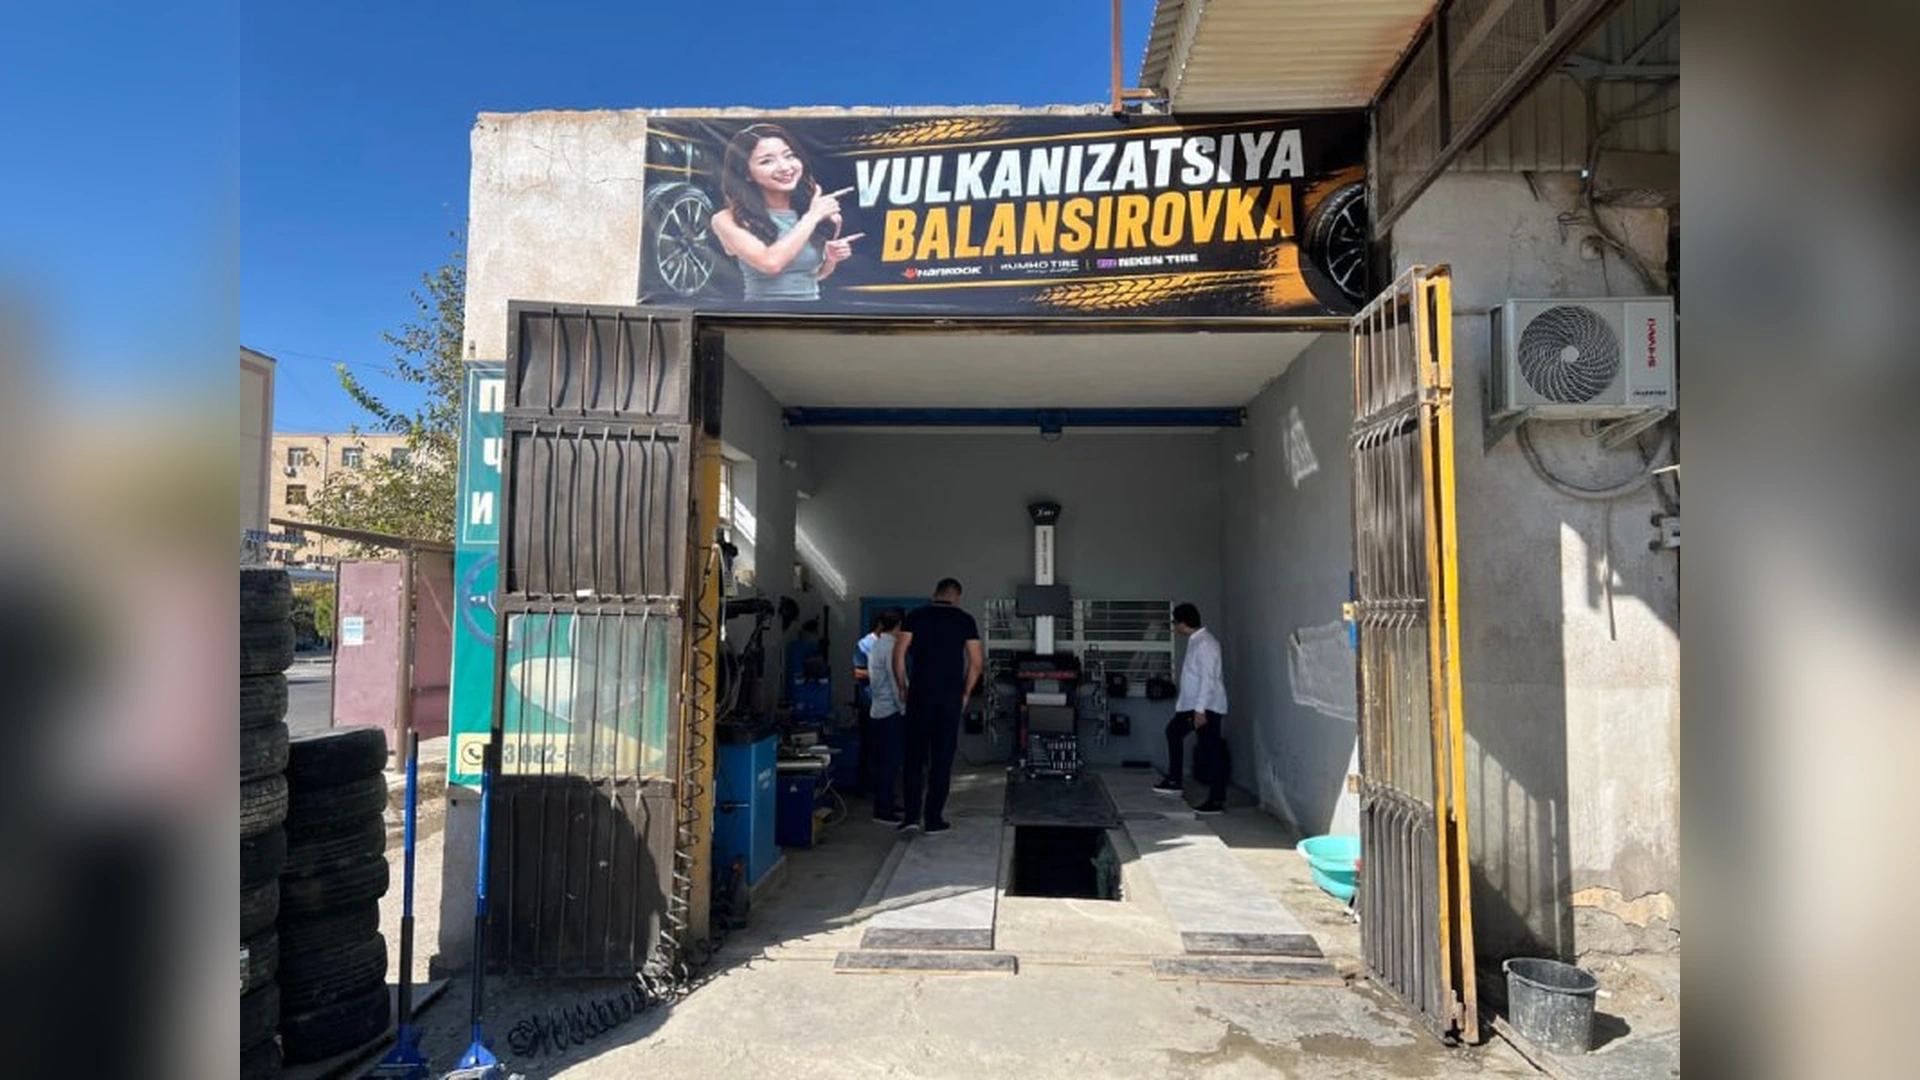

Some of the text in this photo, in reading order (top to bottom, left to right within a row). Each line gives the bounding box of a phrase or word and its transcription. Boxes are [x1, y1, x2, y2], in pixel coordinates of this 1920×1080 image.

[855, 128, 1305, 208] VULKANIZATSIYA
[881, 184, 1295, 262] BALANSIROVKA
[1000, 258, 1080, 271] KUMHO TIRE
[1165, 252, 1199, 263] TIRE
